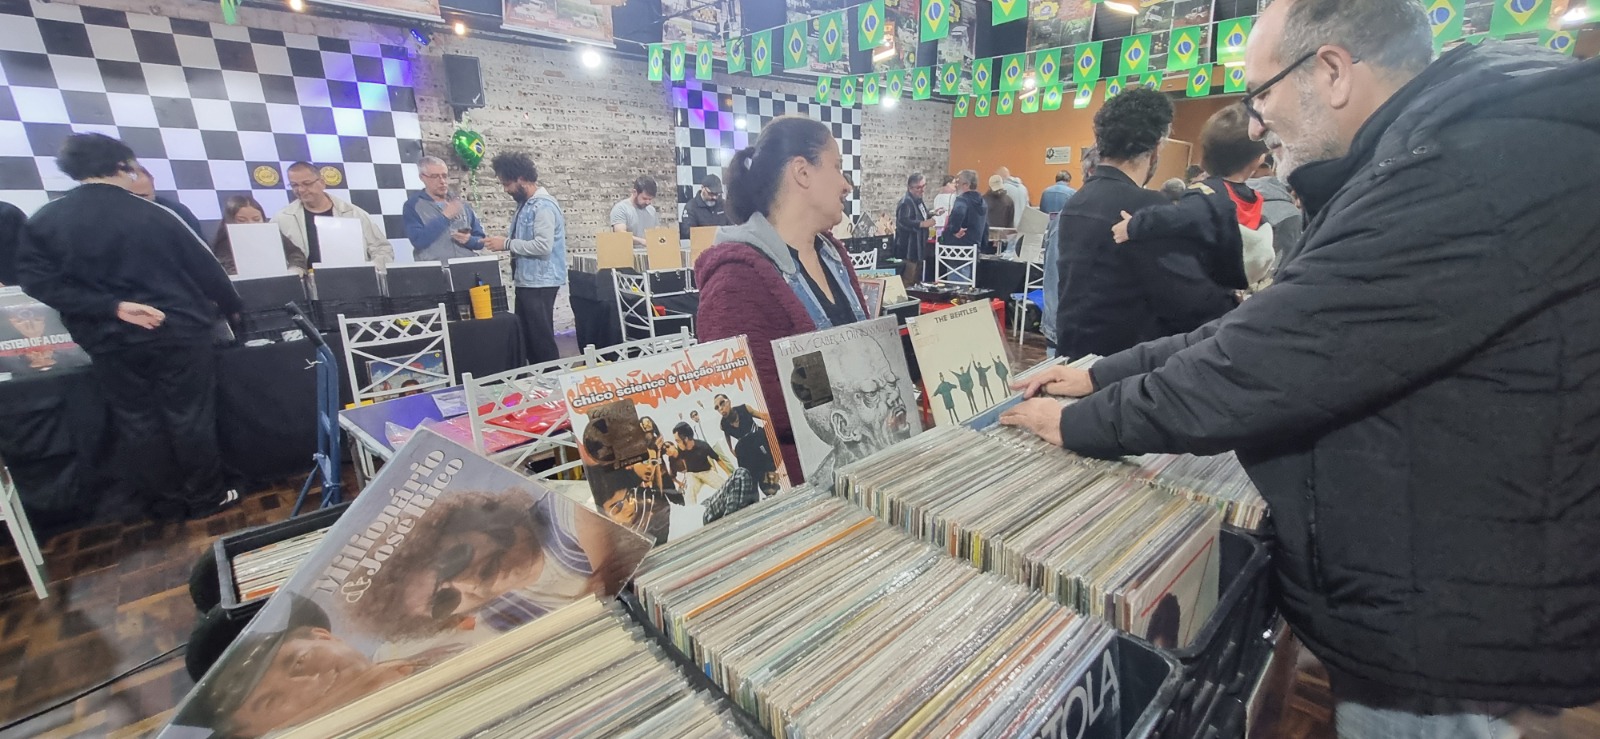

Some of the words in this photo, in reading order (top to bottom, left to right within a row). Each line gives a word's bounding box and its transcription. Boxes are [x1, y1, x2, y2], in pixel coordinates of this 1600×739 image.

[0, 338, 31, 350] YSTEM
[30, 337, 43, 347] OF
[50, 333, 73, 343] DOW
[934, 314, 948, 324] THE
[949, 306, 978, 320] BEATLES
[572, 391, 614, 409] chico
[616, 378, 666, 398] science
[668, 373, 678, 385] &
[679, 366, 714, 382] nação
[715, 356, 749, 373] zumbi
[311, 450, 446, 601] Milionário
[341, 576, 372, 604] &
[358, 517, 416, 576] José
[402, 457, 464, 519] Rico
[1034, 648, 1120, 739] TOLA
